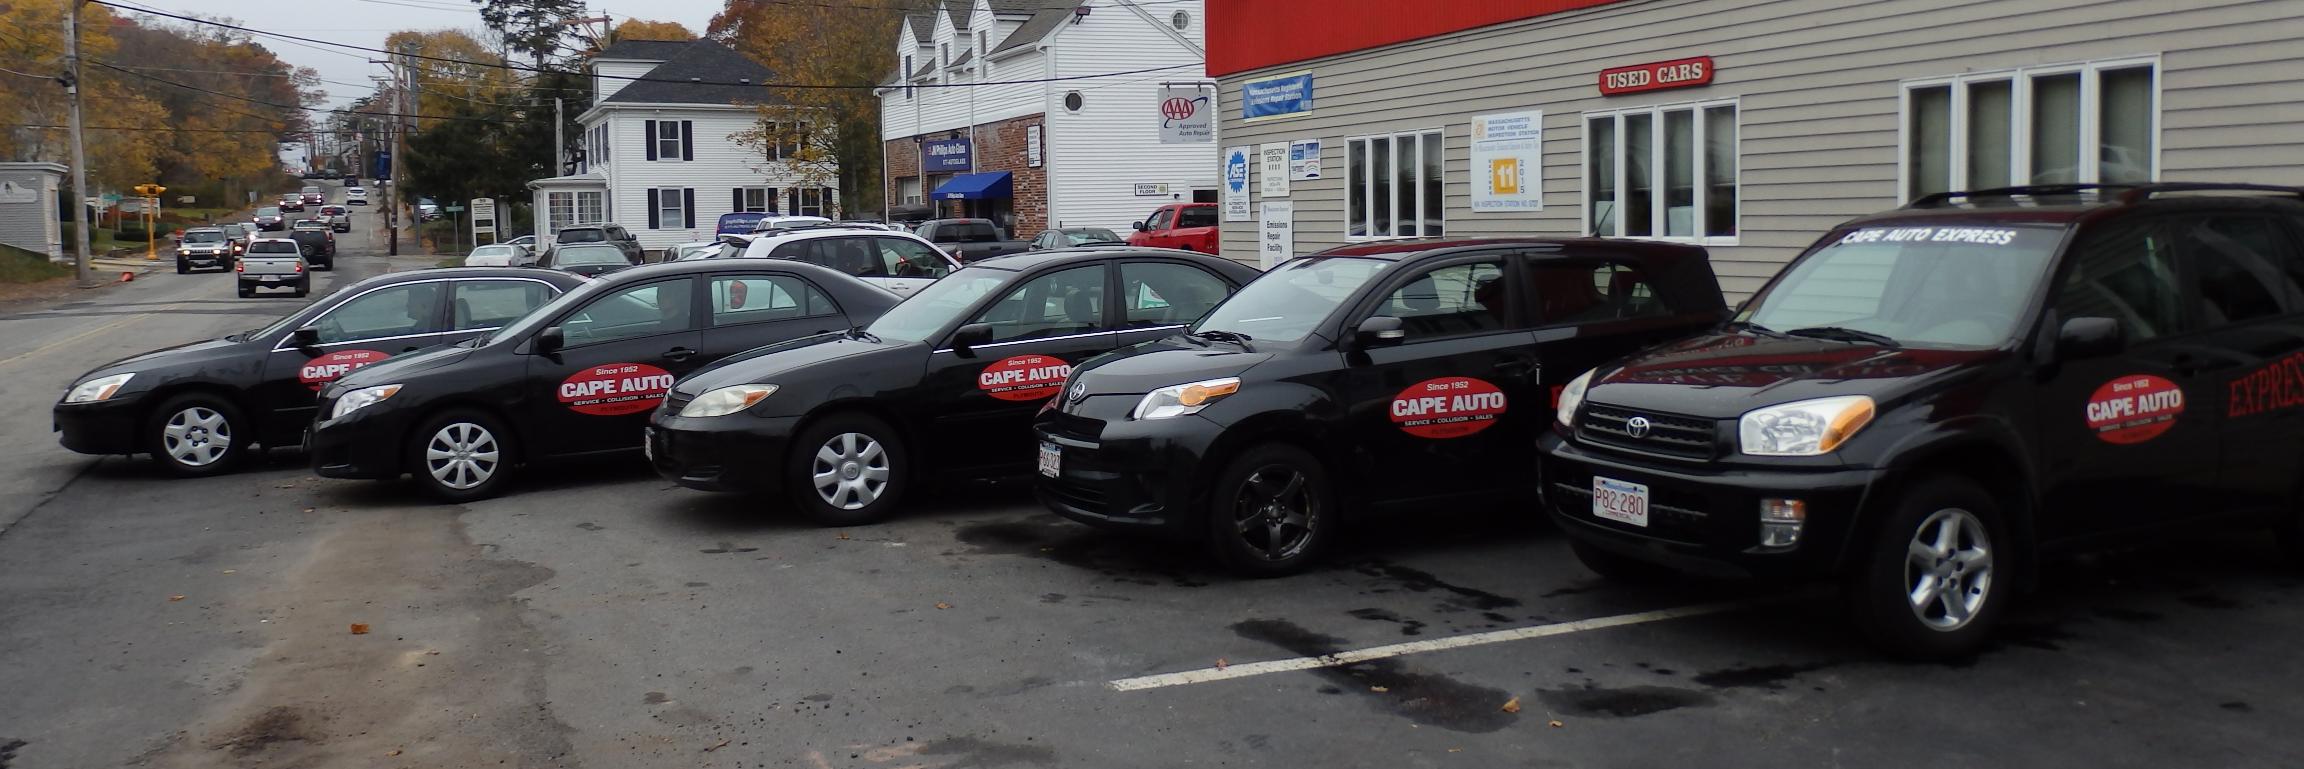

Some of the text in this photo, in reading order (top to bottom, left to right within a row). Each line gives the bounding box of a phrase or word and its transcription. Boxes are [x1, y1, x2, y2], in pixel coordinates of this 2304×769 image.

[1607, 63, 1703, 89] USED CARS
[1164, 98, 1192, 119] AAA
[1488, 117, 1530, 125] MASSACHUSETTS
[1230, 163, 1245, 178] ASE
[1497, 164, 1514, 188] 11
[1267, 232, 1280, 240] Repair
[1841, 228, 2017, 245] CAPE AUTO EXPRESS
[1267, 244, 1282, 253] Facility
[596, 368, 617, 376] Since
[980, 364, 1071, 386] CAPE AUTO
[561, 374, 675, 397] CAPE AUTO
[1427, 381, 1468, 391] Since 1952
[2113, 382, 2132, 392] Since
[1392, 392, 1504, 417] CAPE AUTO
[2087, 388, 2182, 422] CAPE AUTO
[1437, 416, 1468, 424] COLLISION
